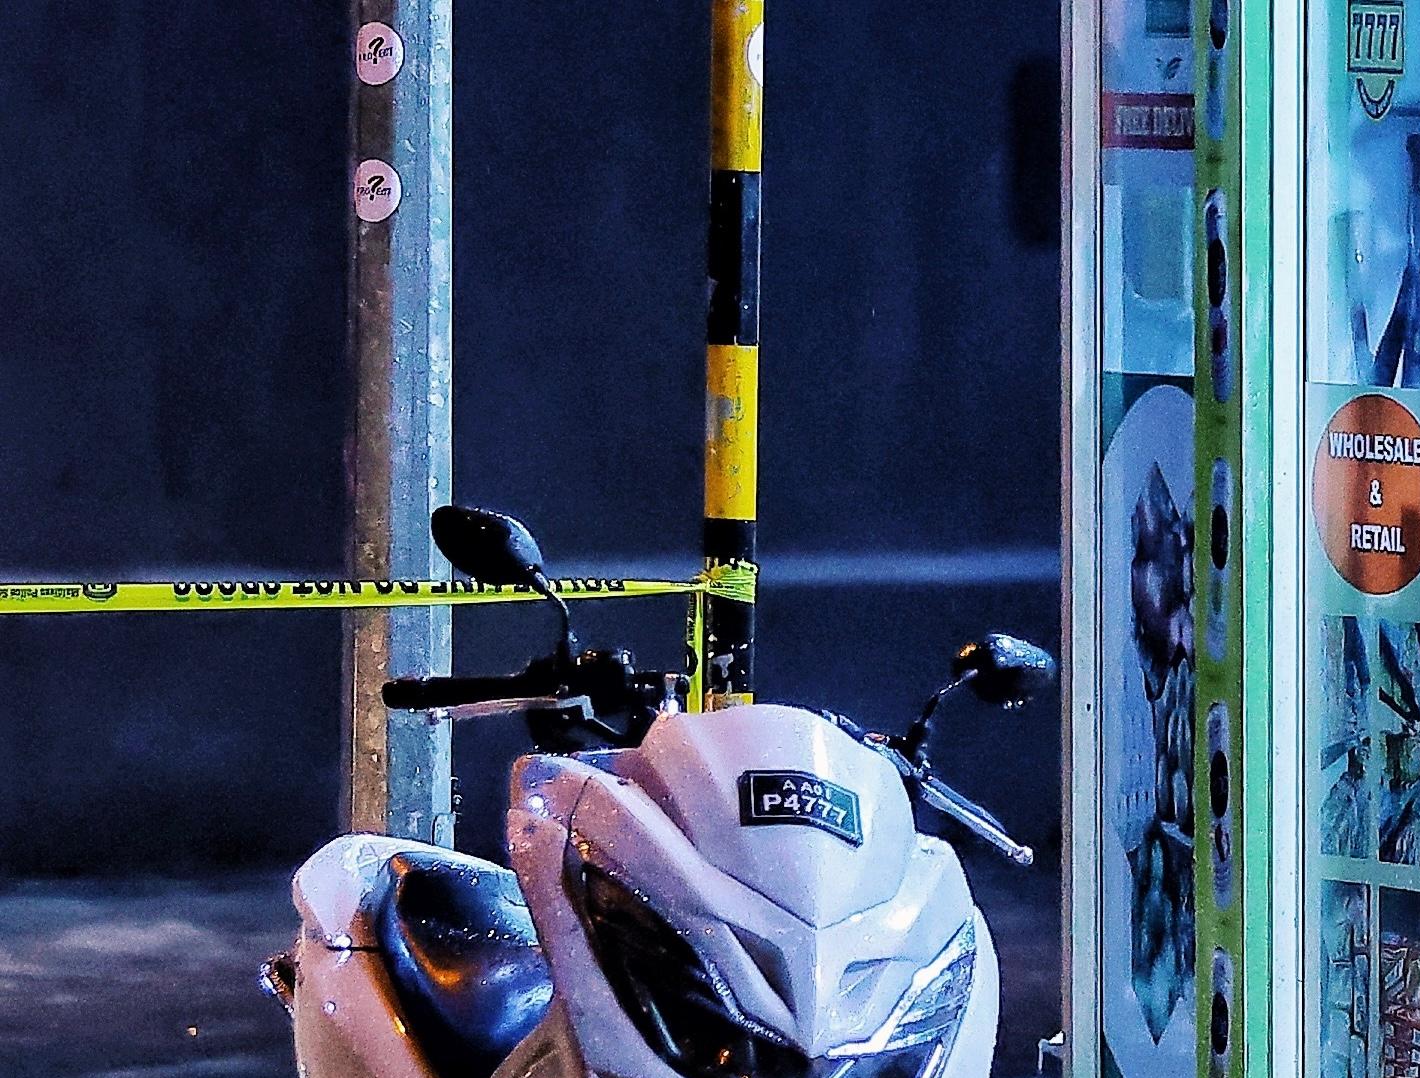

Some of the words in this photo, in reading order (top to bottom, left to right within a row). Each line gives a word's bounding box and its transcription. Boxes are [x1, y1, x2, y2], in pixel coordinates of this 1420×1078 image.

[1353, 13, 1400, 60] 7777
[1369, 479, 1383, 507] &
[1351, 522, 1406, 554] RETAIL
[763, 793, 847, 825] P4777
